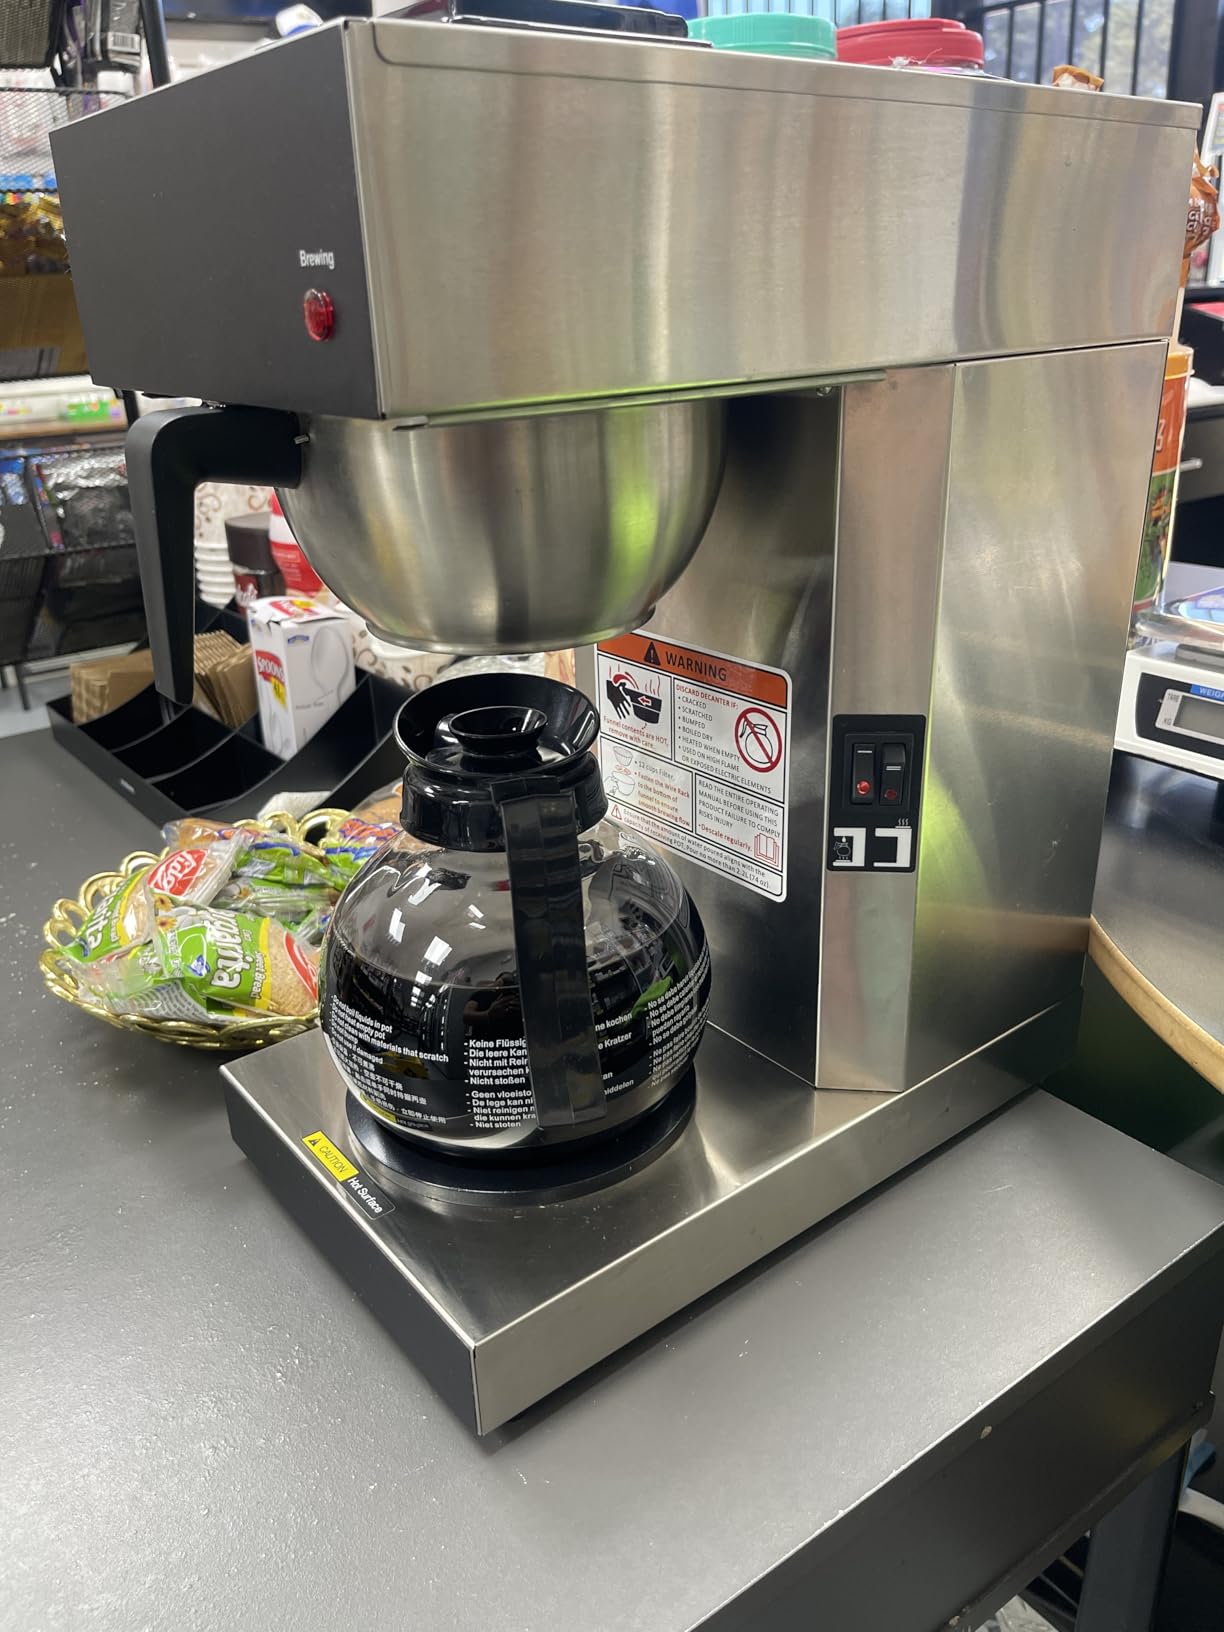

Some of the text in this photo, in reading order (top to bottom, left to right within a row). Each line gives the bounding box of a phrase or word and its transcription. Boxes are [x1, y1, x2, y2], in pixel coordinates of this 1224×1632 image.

[299, 248, 335, 270] Brewing
[665, 651, 728, 682] WARNING
[676, 684, 739, 710] DISCARD DECANTER IF:
[682, 696, 706, 709] CRACKED
[682, 706, 713, 722] SCRATCHED
[682, 716, 706, 729] BUMPED
[604, 715, 621, 727] Funnel
[622, 724, 645, 737] contents
[656, 736, 669, 748] HOT,
[609, 727, 628, 738] remove
[630, 735, 641, 743] with
[682, 726, 713, 742] BOILED DRY
[682, 735, 740, 762] HEATED WHEN EMPTY
[682, 745, 740, 772] USED ON HIGH FLAME
[646, 765, 658, 774] cups
[682, 754, 772, 794] OR EXPOSED ELECTRIC ELEMENTS
[678, 788, 689, 798] Rack
[699, 780, 779, 817] READ THE ENTIRE OPERATING
[699, 790, 778, 827] MANUAL BEFORE USING THIS
[699, 809, 733, 828] RISKS INJURY
[699, 800, 781, 838] PRODUCT FAILURE TO COMPLY
[624, 808, 640, 820] Ensure
[640, 816, 650, 826] that
[651, 821, 660, 829] the
[661, 826, 680, 840] amount
[688, 838, 703, 849] water
[704, 845, 723, 858] poured
[724, 854, 740, 866] aligns
[742, 862, 754, 873] with
[755, 868, 766, 877] the
[701, 824, 753, 852] Descale regularly.
[707, 856, 722, 866] more
[722, 861, 736, 872] than
[250, 972, 266, 999] Bread
[648, 1000, 658, 1010] No
[657, 996, 665, 1004] se
[665, 986, 678, 1000] debe
[650, 1009, 659, 1019] No
[659, 1005, 666, 1013] se
[667, 995, 679, 1008] debe
[345, 1013, 356, 1026] heat
[356, 1022, 374, 1037] empty
[374, 1030, 386, 1040] pot
[346, 1005, 355, 1017] boil
[355, 1010, 374, 1026] liquids
[374, 1020, 380, 1029] in
[381, 1024, 392, 1034] pot
[606, 1012, 633, 1027] kochen
[651, 1009, 674, 1028] No debe
[652, 1018, 674, 1038] puedan
[344, 1030, 358, 1045] bump
[604, 1032, 632, 1048] Kratzer
[653, 1035, 662, 1045] No
[662, 1030, 670, 1039] se
[670, 1020, 682, 1034] debe
[344, 1023, 358, 1036] clean
[358, 1032, 370, 1043] with
[370, 1038, 402, 1054] materials
[402, 1047, 418, 1058] that
[418, 1051, 449, 1063] scratch
[469, 1039, 494, 1048] Keine
[662, 1041, 673, 1053] pas
[356, 1048, 384, 1065] damaged
[469, 1048, 528, 1058] Die leere Kan
[469, 1058, 508, 1067] Nicht mit
[469, 1068, 524, 1076] verursachen
[470, 1076, 526, 1085] Nicht stoßen
[471, 1090, 532, 1098] Geen vloeisto
[472, 1098, 485, 1106] De
[486, 1099, 506, 1108] lege
[507, 1098, 523, 1106] kan
[492, 1106, 528, 1115] reinigen
[319, 1145, 347, 1173] CAUTION
[346, 1176, 383, 1214] Hot Surface
